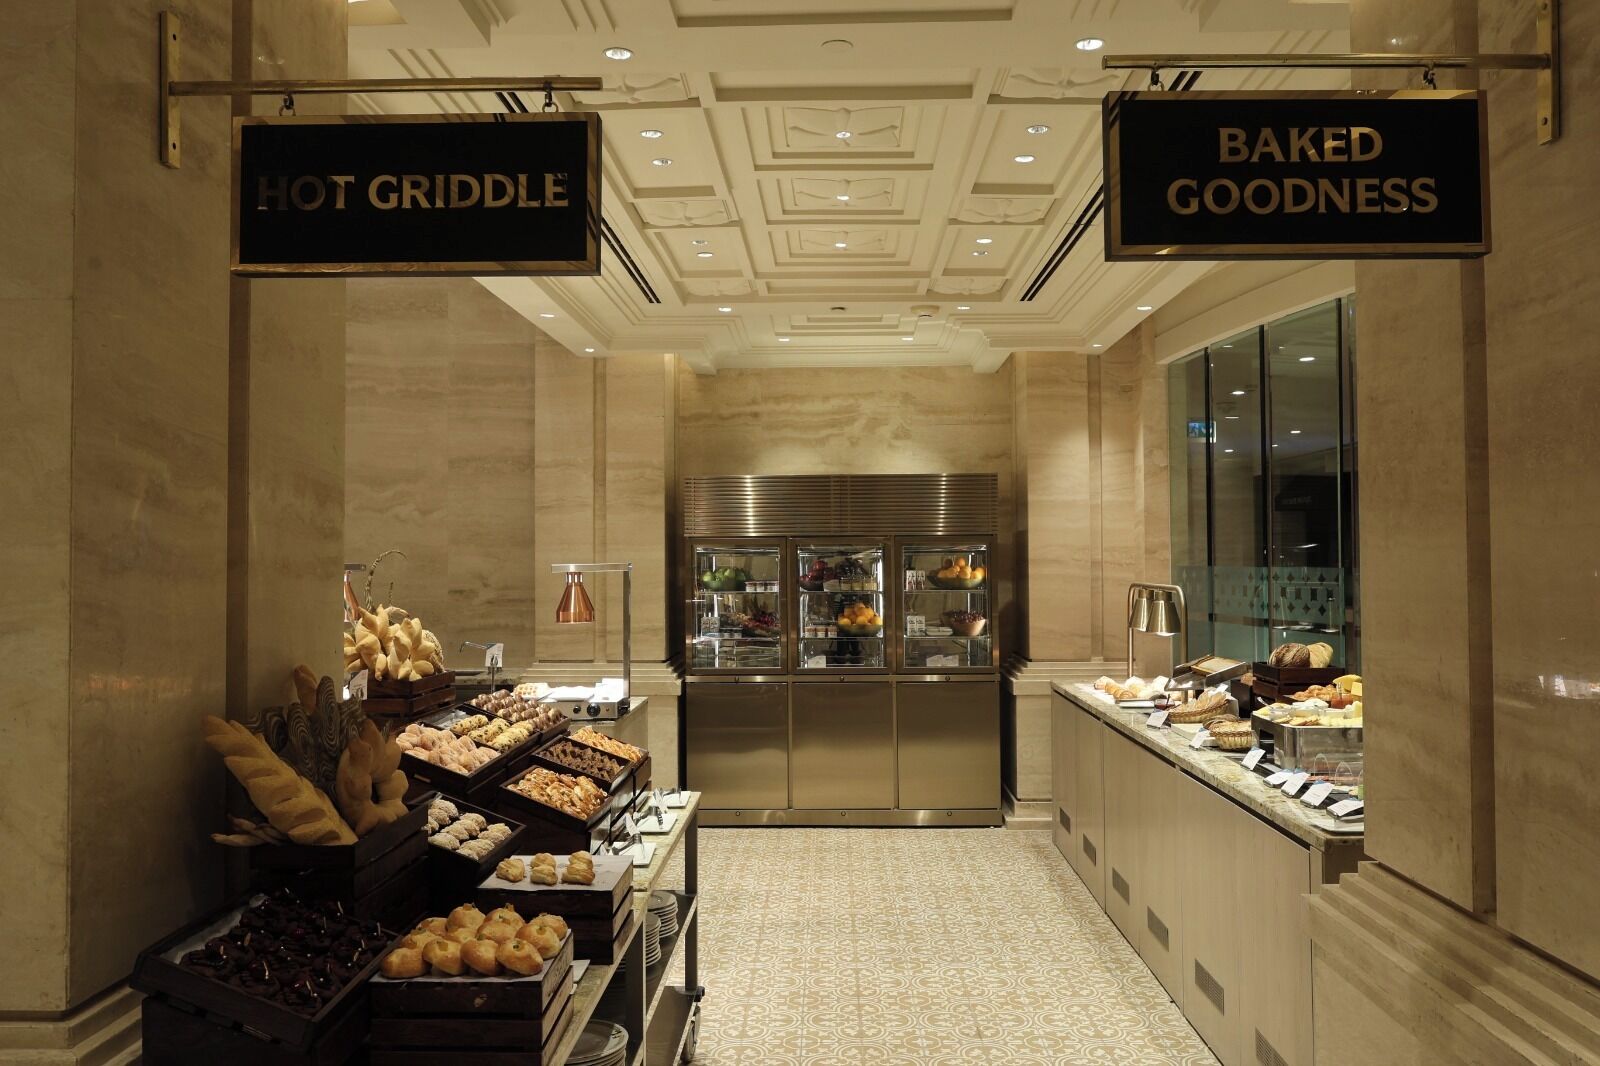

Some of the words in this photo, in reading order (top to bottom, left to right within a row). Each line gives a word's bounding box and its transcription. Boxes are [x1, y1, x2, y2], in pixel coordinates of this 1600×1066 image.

[1217, 126, 1384, 164] BAKED
[257, 174, 355, 211] HOT
[367, 172, 569, 210] GRIDDLE
[1166, 176, 1439, 215] GOODNESS
